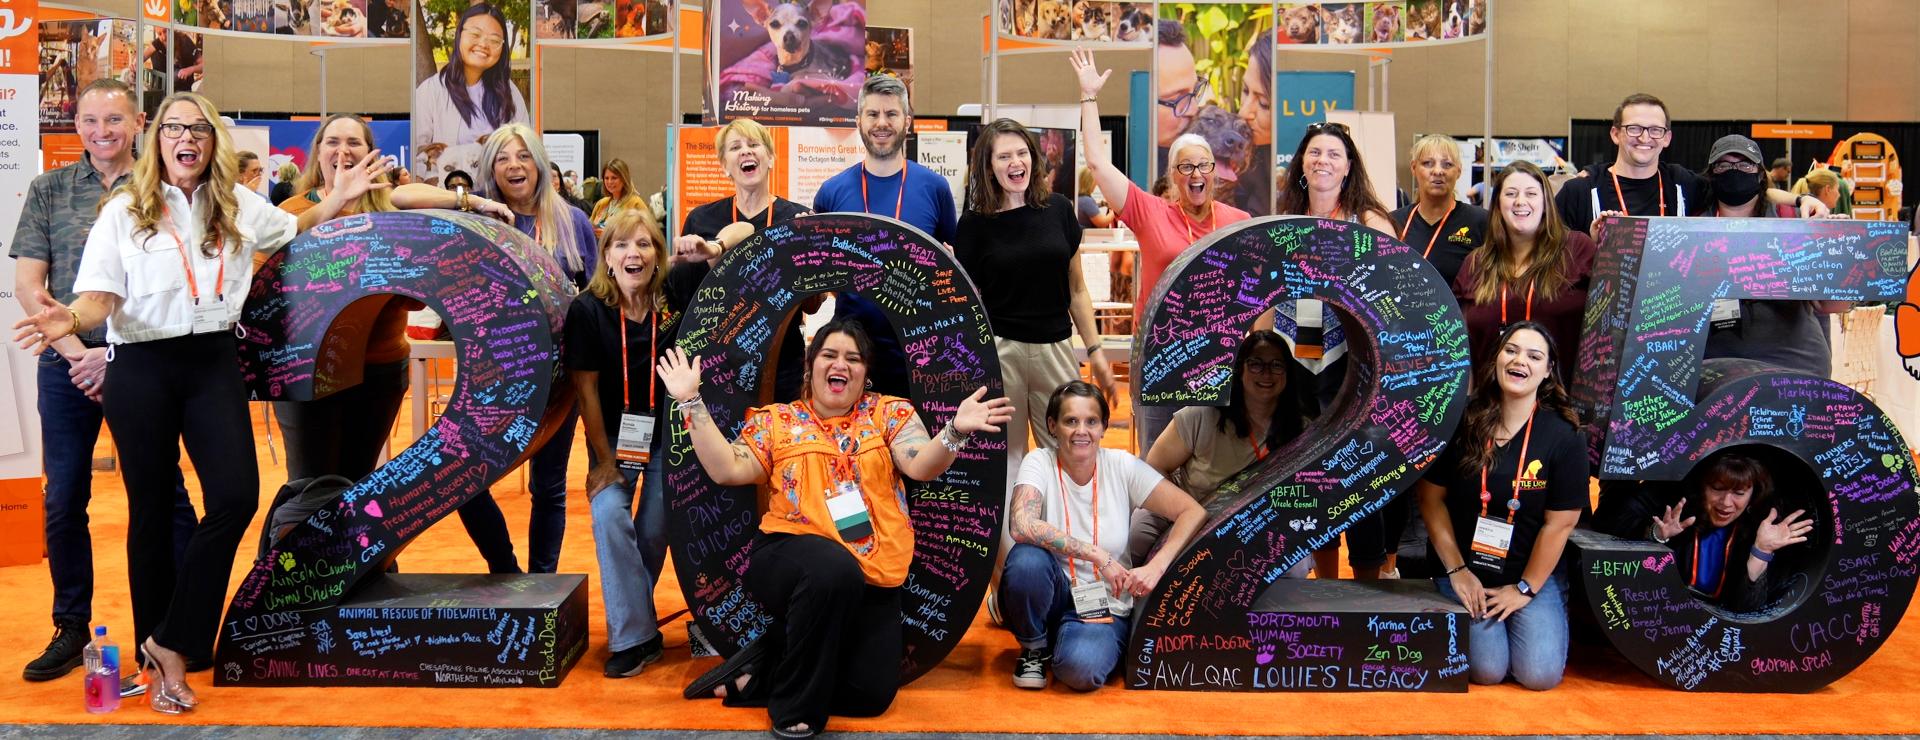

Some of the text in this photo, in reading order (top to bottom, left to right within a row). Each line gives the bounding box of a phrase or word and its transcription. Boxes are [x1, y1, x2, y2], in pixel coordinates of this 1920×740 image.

[733, 90, 772, 105] Making
[725, 100, 760, 116] History
[798, 106, 811, 114] pets
[798, 144, 858, 156] Borrowing Great
[920, 152, 946, 164] Meet
[809, 156, 830, 164] Octagon
[1814, 438, 1856, 464] PLAYERS
[1620, 586, 1671, 602] Rescue
[338, 608, 497, 620] ANIMAL RESCUE OF TIDEWATER
[1247, 612, 1340, 628] PORTSMOUTH
[227, 620, 242, 637] I
[1367, 615, 1434, 638] Karma Cat
[1250, 630, 1302, 644] HUMANE
[1286, 644, 1344, 660] SOCIETY
[1364, 645, 1423, 664] Zen Dog
[254, 658, 300, 679] SAVING
[307, 662, 338, 678] LIVES
[1253, 664, 1429, 690] LOUIE'S LEGACY
